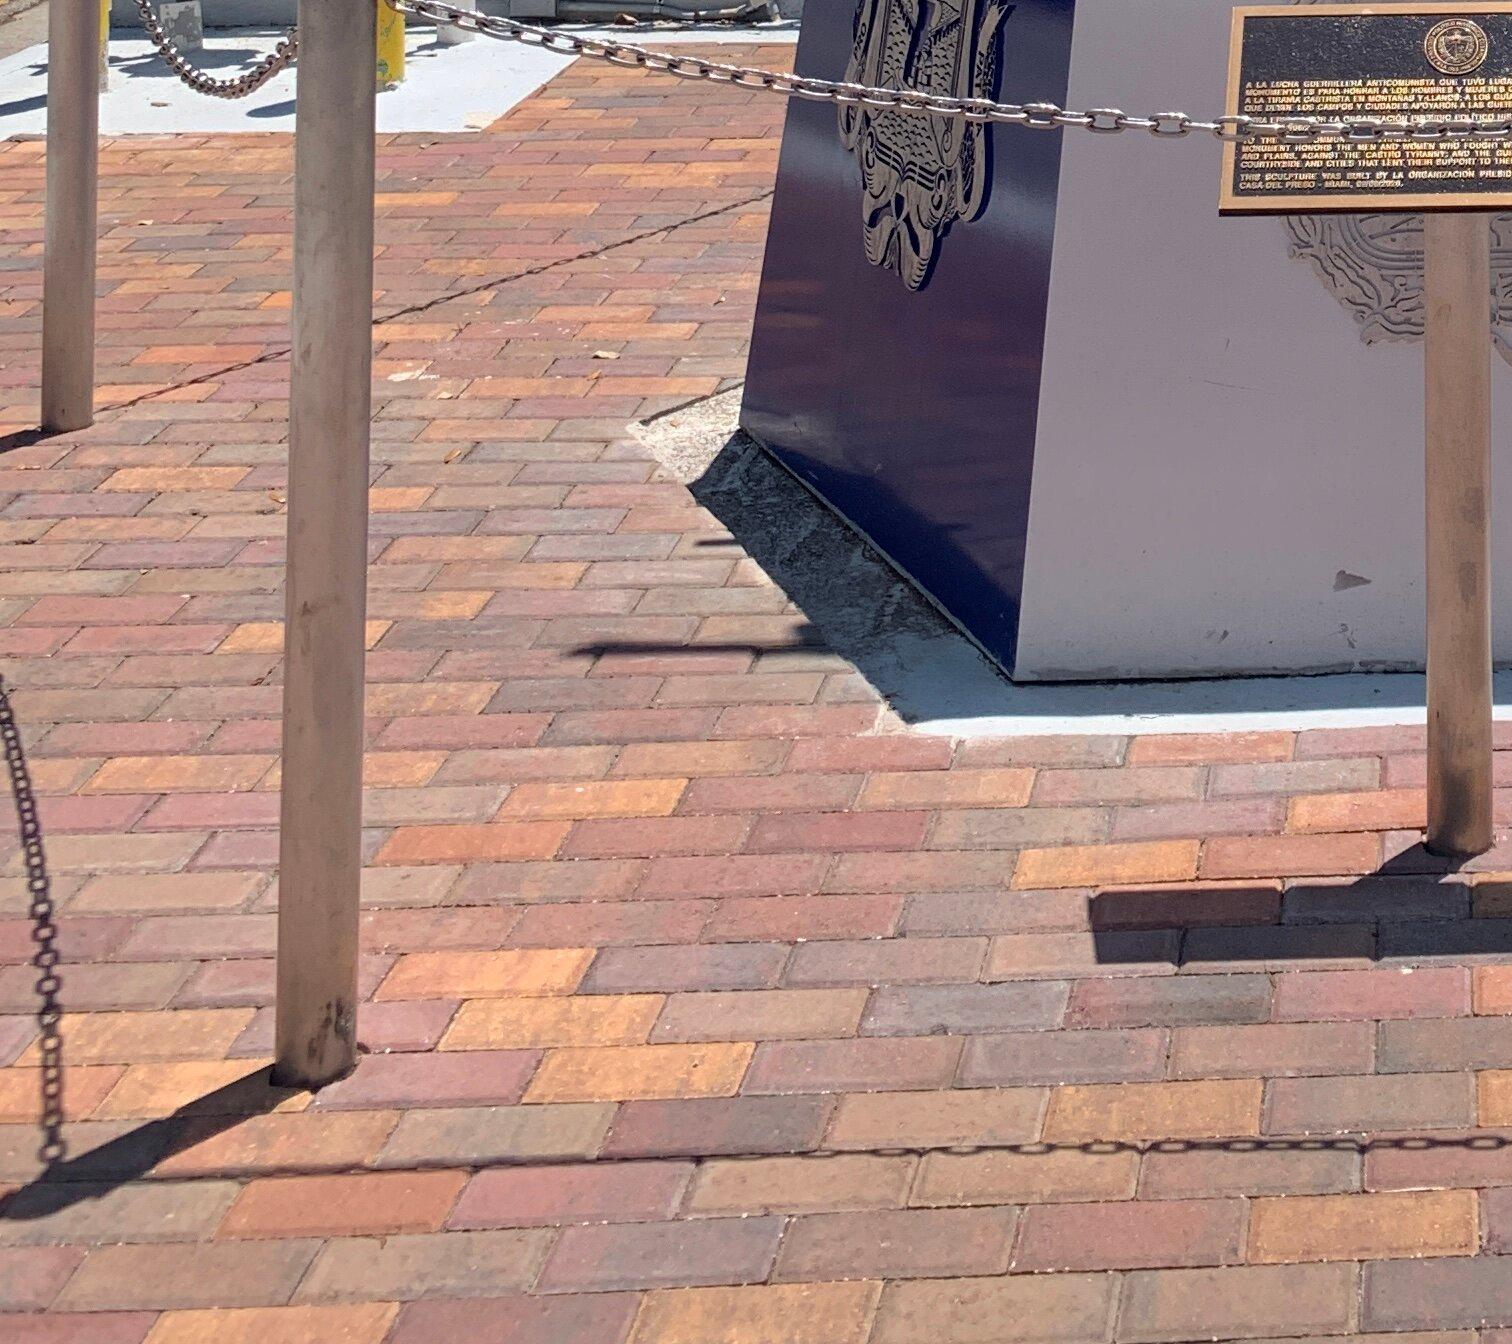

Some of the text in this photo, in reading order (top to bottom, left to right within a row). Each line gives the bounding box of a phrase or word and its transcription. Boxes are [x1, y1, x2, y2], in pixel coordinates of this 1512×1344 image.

[1366, 79, 1435, 87] ANTICOMUNISTA
[1462, 78, 1485, 86] TUVO
[1245, 88, 1300, 96] MONUMENTO
[1318, 87, 1340, 95] PARA
[1343, 87, 1380, 95] HONRAR
[1411, 86, 1454, 94] HOMBRES
[1465, 86, 1505, 94] MUJERES
[1317, 103, 1353, 111] CAMPOS
[1411, 102, 1457, 110] APOYARON
[1242, 144, 1291, 152] MONUMENT
[1357, 143, 1376, 151] MEN
[1380, 143, 1400, 151] AND
[1439, 142, 1460, 150] WHO
[1463, 142, 1498, 150] FOUGHT
[1242, 152, 1260, 160] AND
[1365, 151, 1401, 159] CASTRO
[1452, 150, 1470, 158] AND
[1241, 160, 1300, 168] COUNTRYSIDE
[1326, 159, 1354, 167] CITIES
[1358, 159, 1379, 167] THAT
[1407, 158, 1433, 166] THEIR
[1240, 173, 1260, 181] THIS
[1265, 173, 1317, 181] SCULPTURE
[1322, 172, 1341, 180] WAS
[1347, 172, 1370, 180] BUILT
[1240, 181, 1263, 189] CASA
[1265, 181, 1283, 189] DEL
